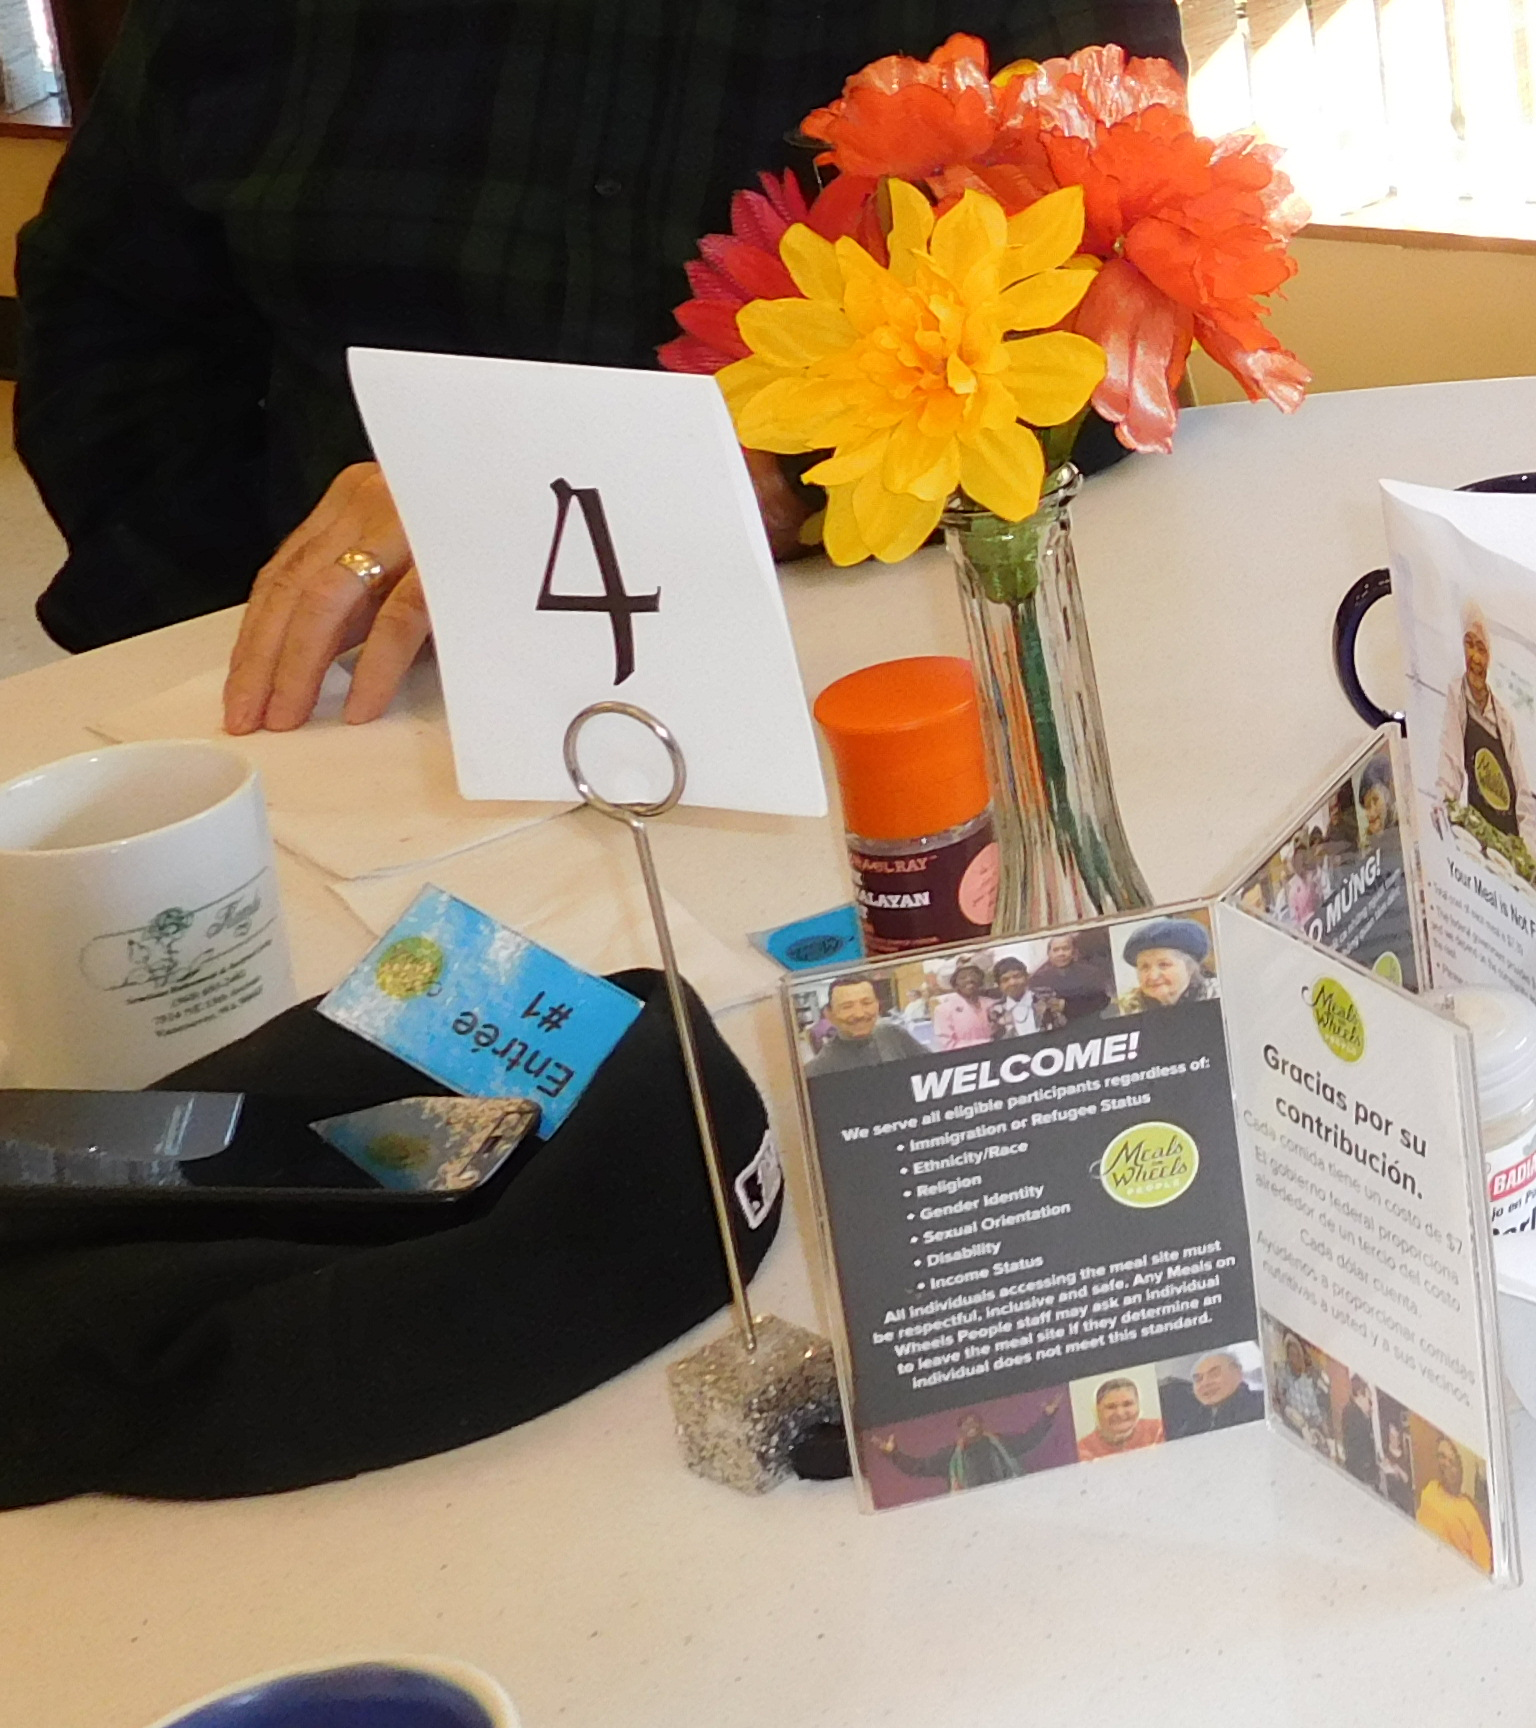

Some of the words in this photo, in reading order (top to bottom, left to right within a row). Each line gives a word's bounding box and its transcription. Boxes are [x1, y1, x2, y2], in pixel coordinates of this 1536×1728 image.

[535, 477, 661, 686] 4
[521, 991, 574, 1033] #1
[452, 1010, 575, 1098] Entrée
[911, 1031, 1140, 1103] WELCOME!
[841, 1127, 869, 1142] We
[873, 1118, 918, 1136] serve
[921, 1110, 941, 1126] all
[944, 1099, 1003, 1120] eligible
[1007, 1078, 1101, 1110] participants
[1104, 1062, 1187, 1088] regardless
[1190, 1056, 1210, 1071] of:
[909, 1123, 1007, 1152] Immigration
[1010, 1118, 1028, 1130] or
[1031, 1103, 1097, 1128] Refugee
[1100, 1092, 1151, 1113] Status
[1263, 1043, 1348, 1112] Gracias
[1355, 1101, 1394, 1136] por
[1400, 1128, 1427, 1158] su
[912, 1142, 1029, 1175] Ethnicity/Race
[1103, 1134, 1183, 1175] Meals
[1112, 1157, 1188, 1188] Wheels
[1276, 1097, 1423, 1200] contribución.
[916, 1175, 982, 1198] Religion
[919, 1198, 980, 1221] Gender
[983, 1185, 1044, 1207] Identity
[923, 1221, 978, 1245] Sexual
[981, 1203, 1071, 1231] Orientation
[926, 1241, 1002, 1268] Disability
[872, 1331, 894, 1345] be
[898, 1309, 983, 1339] respectful,
[985, 1294, 1055, 1319] inclusive
[1058, 1285, 1088, 1303] and
[1091, 1278, 1130, 1296] safe.
[1132, 1271, 1164, 1287] Any
[1166, 1260, 1213, 1280] Meals
[1215, 1255, 1236, 1269] on
[883, 1308, 906, 1325] All
[908, 1288, 996, 1319] individuals
[999, 1272, 1077, 1298] accessing
[1079, 1265, 1106, 1280] the
[1109, 1254, 1148, 1274] meal
[1151, 1249, 1180, 1265] site
[1182, 1239, 1222, 1258] must
[930, 1268, 990, 1290] Income
[992, 1256, 1044, 1276] Status
[894, 1334, 954, 1358] Wheels
[957, 1321, 1013, 1343] People
[1016, 1310, 1052, 1329] staff
[1055, 1304, 1088, 1321] may
[1092, 1296, 1119, 1312] ask
[1123, 1293, 1142, 1306] an
[1145, 1274, 1221, 1301] individual
[897, 1362, 915, 1375] to
[917, 1351, 961, 1370] leave
[963, 1344, 991, 1359] the
[994, 1332, 1034, 1352] meal
[1036, 1326, 1065, 1342] site
[1068, 1322, 1080, 1336] if
[1082, 1315, 1118, 1333] they
[1121, 1298, 1200, 1325] determine
[1203, 1293, 1223, 1307] an
[912, 1359, 990, 1390] individual
[993, 1352, 1032, 1371] does
[1035, 1344, 1063, 1361] not
[1065, 1335, 1105, 1354] meet
[1108, 1328, 1138, 1344] this
[1140, 1311, 1213, 1338] standard.
